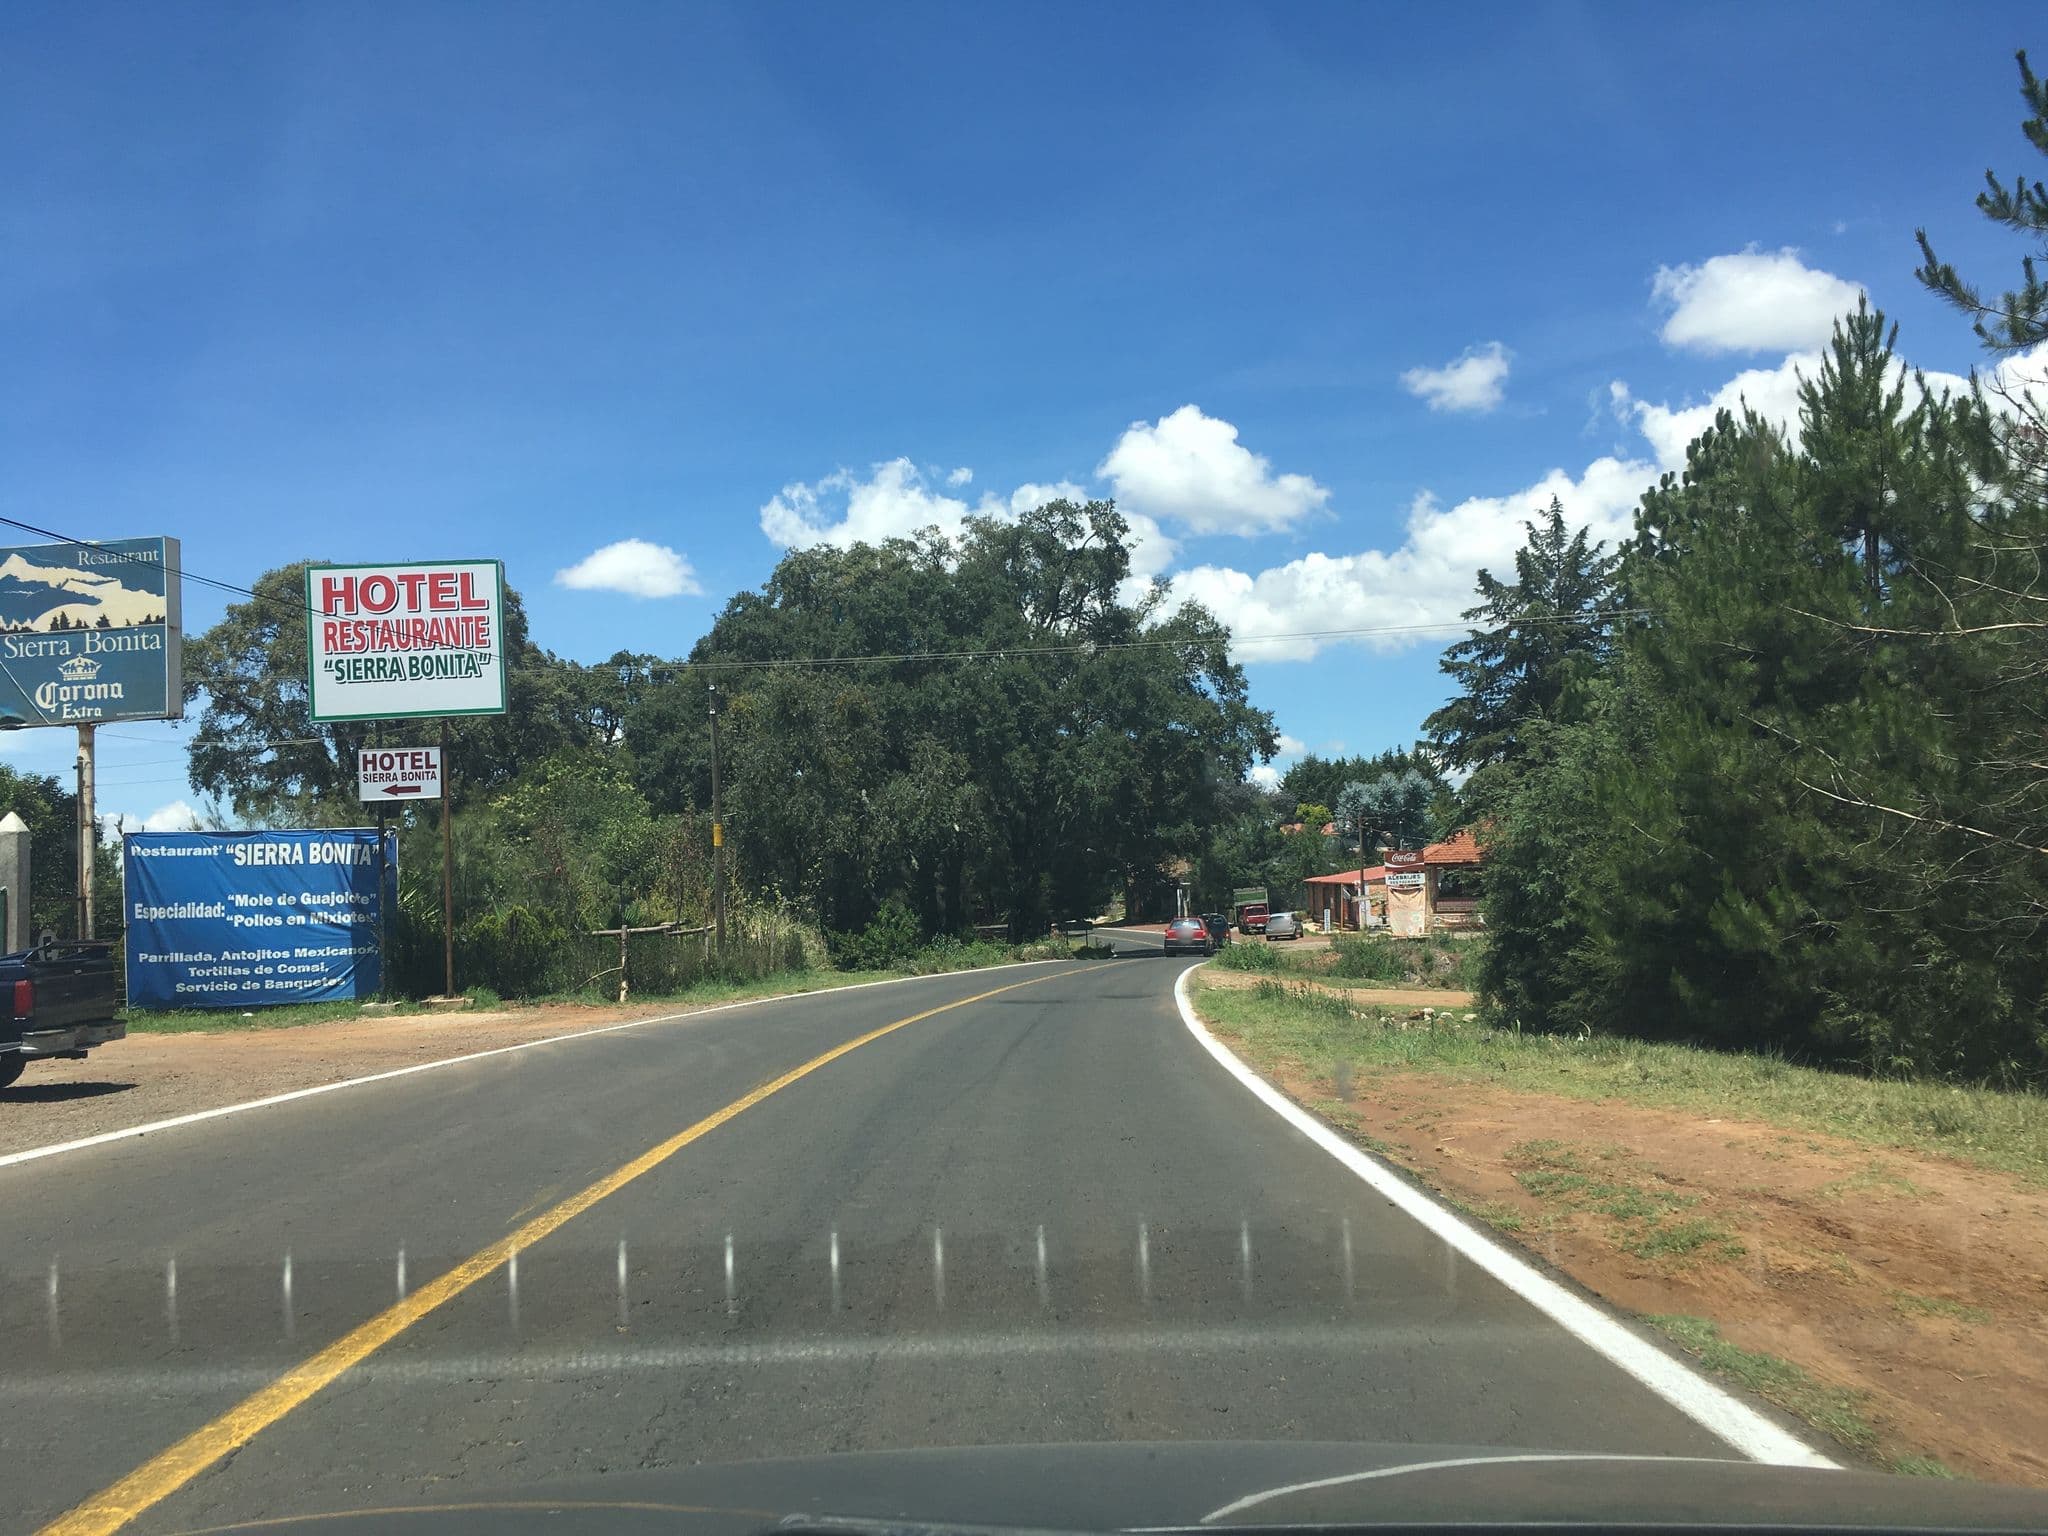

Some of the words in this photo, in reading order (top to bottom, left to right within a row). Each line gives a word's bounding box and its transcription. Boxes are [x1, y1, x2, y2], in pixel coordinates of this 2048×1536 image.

[78, 549, 160, 566] Restaurant
[321, 571, 489, 616] HOTEL
[4, 635, 71, 659] Sierra
[84, 628, 162, 654] Bonita
[323, 615, 490, 655] RESTAURANTE
[324, 656, 406, 684] “SIERRA
[409, 653, 491, 679] BONITA”
[35, 681, 124, 713] Corona
[62, 703, 103, 719] Extra
[361, 751, 438, 772] HOTEL
[362, 772, 399, 784] SIERRA
[401, 770, 437, 782] BONITA
[226, 842, 304, 866] “SIERRA
[1391, 852, 1417, 862] Coca-Cola
[227, 893, 274, 907] “Mole
[277, 892, 296, 906] de
[134, 902, 225, 922] Especialidad:
[226, 913, 283, 928] “Pollos
[286, 915, 306, 926] en
[138, 951, 217, 963] Parrillada,
[221, 949, 290, 962] Antojitos
[294, 945, 379, 959] Mexicanos,
[188, 965, 250, 977] Tortillas
[254, 964, 272, 975] de
[277, 962, 329, 974] Comal,
[175, 980, 238, 993] Servicio
[243, 980, 260, 991] de
[264, 977, 346, 990] Banquetes
